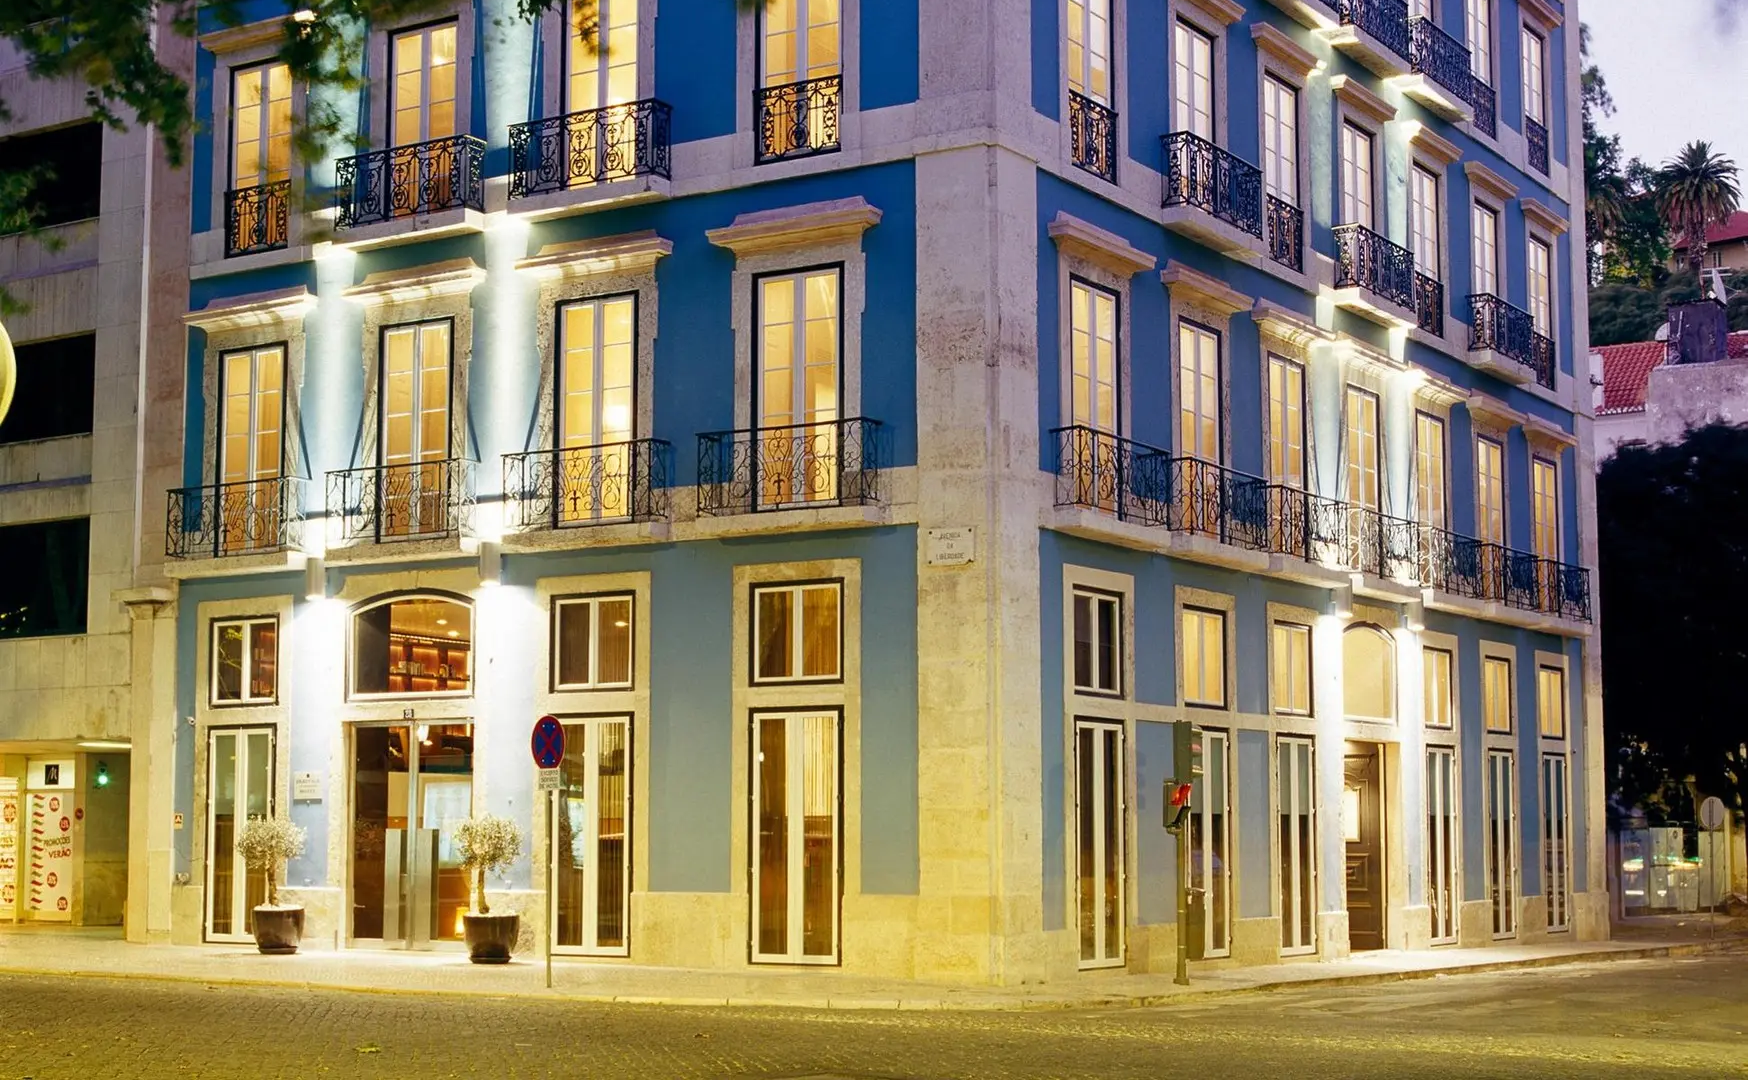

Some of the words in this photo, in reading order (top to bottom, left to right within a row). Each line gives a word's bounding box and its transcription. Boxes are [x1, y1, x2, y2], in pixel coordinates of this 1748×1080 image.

[939, 531, 961, 540] AVENIDA
[935, 552, 965, 561] LIBERDADE
[48, 846, 72, 859] VERÃO
